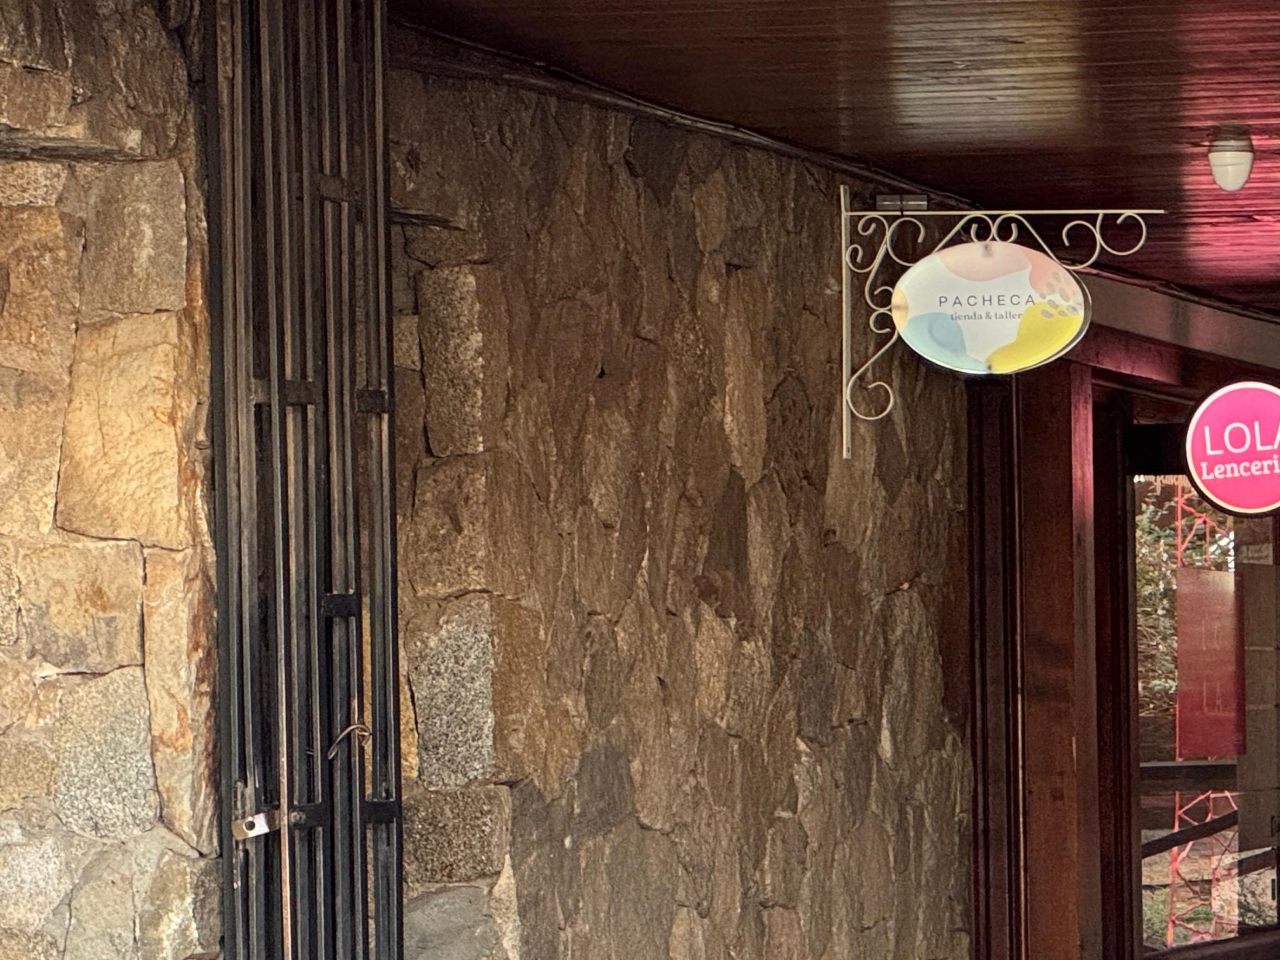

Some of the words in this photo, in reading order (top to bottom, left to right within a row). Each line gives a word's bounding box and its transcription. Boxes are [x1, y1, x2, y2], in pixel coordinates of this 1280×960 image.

[939, 294, 1036, 307] PACHECA
[950, 311, 983, 321] tienda
[984, 311, 992, 320] &
[994, 311, 1023, 320] taller
